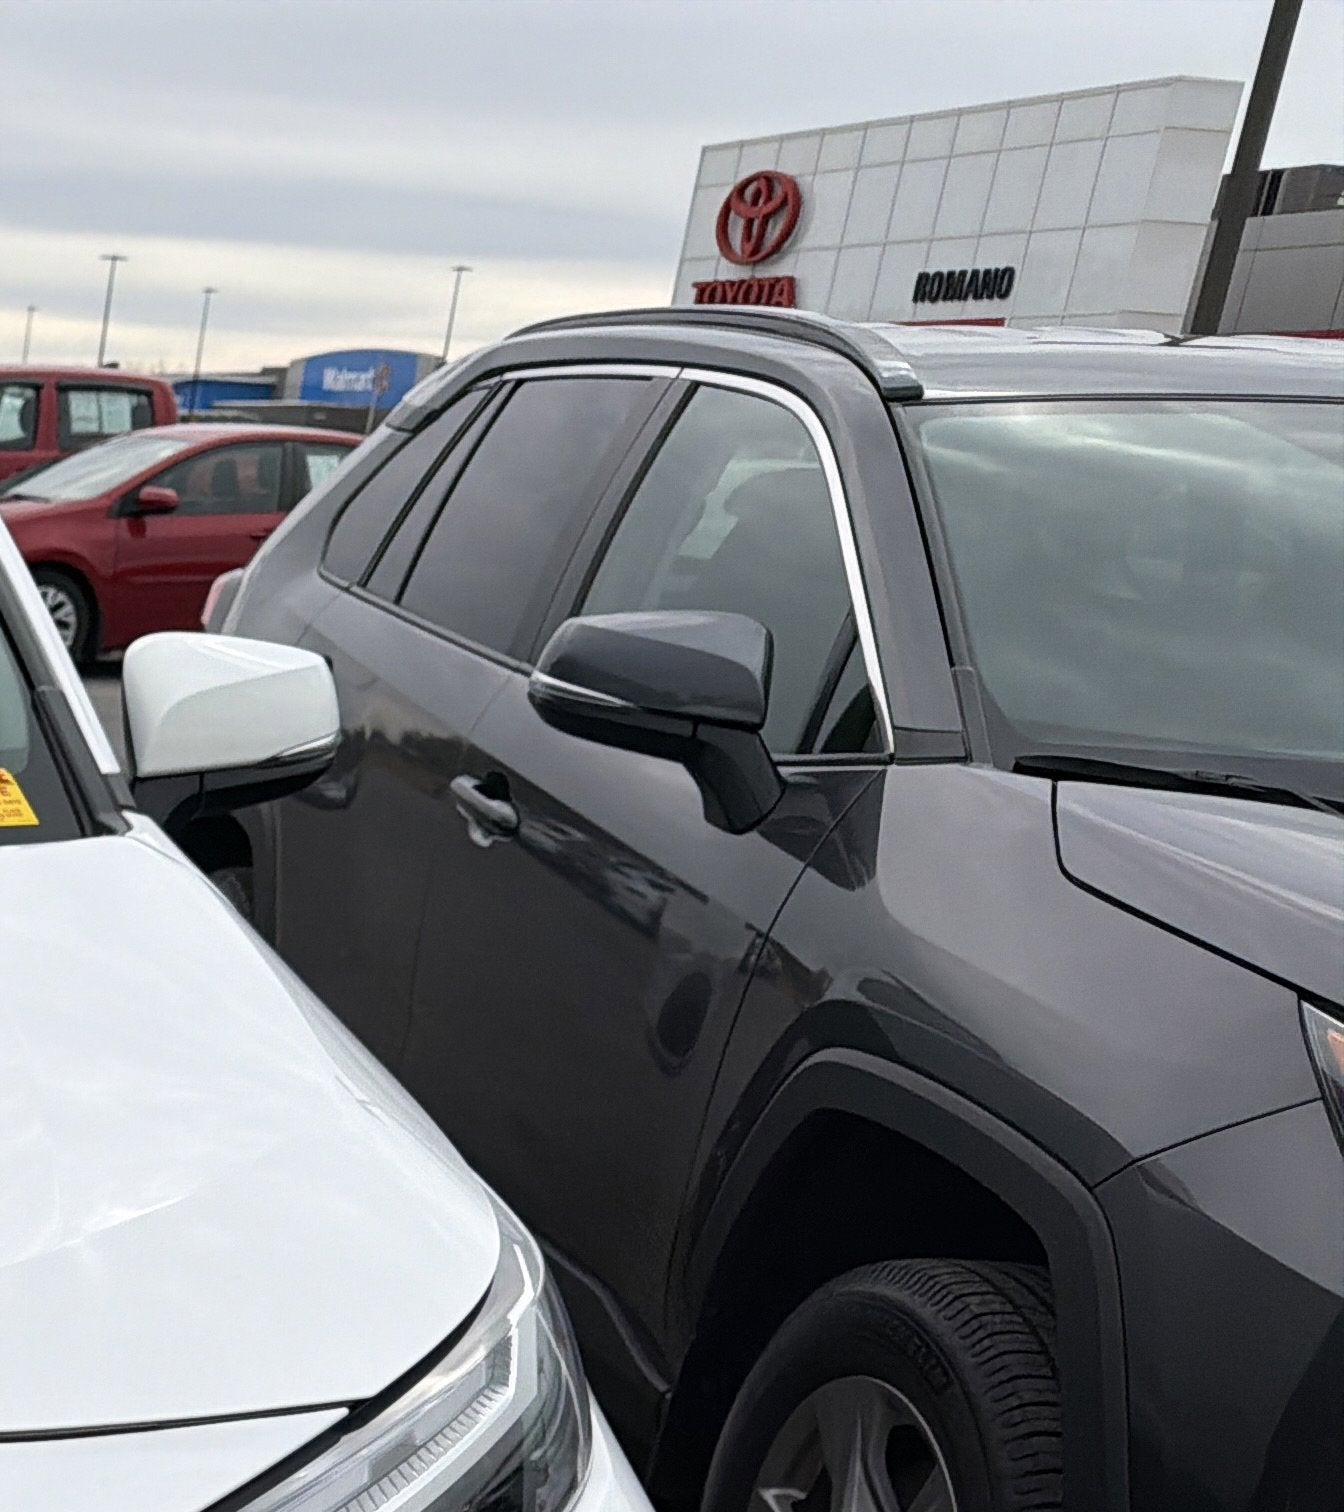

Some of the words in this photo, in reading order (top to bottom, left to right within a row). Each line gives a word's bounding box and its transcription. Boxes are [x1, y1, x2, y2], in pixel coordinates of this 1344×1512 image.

[692, 275, 796, 308] TOYOTA
[912, 266, 1015, 304] ROMANO
[322, 366, 375, 392] Walmart
